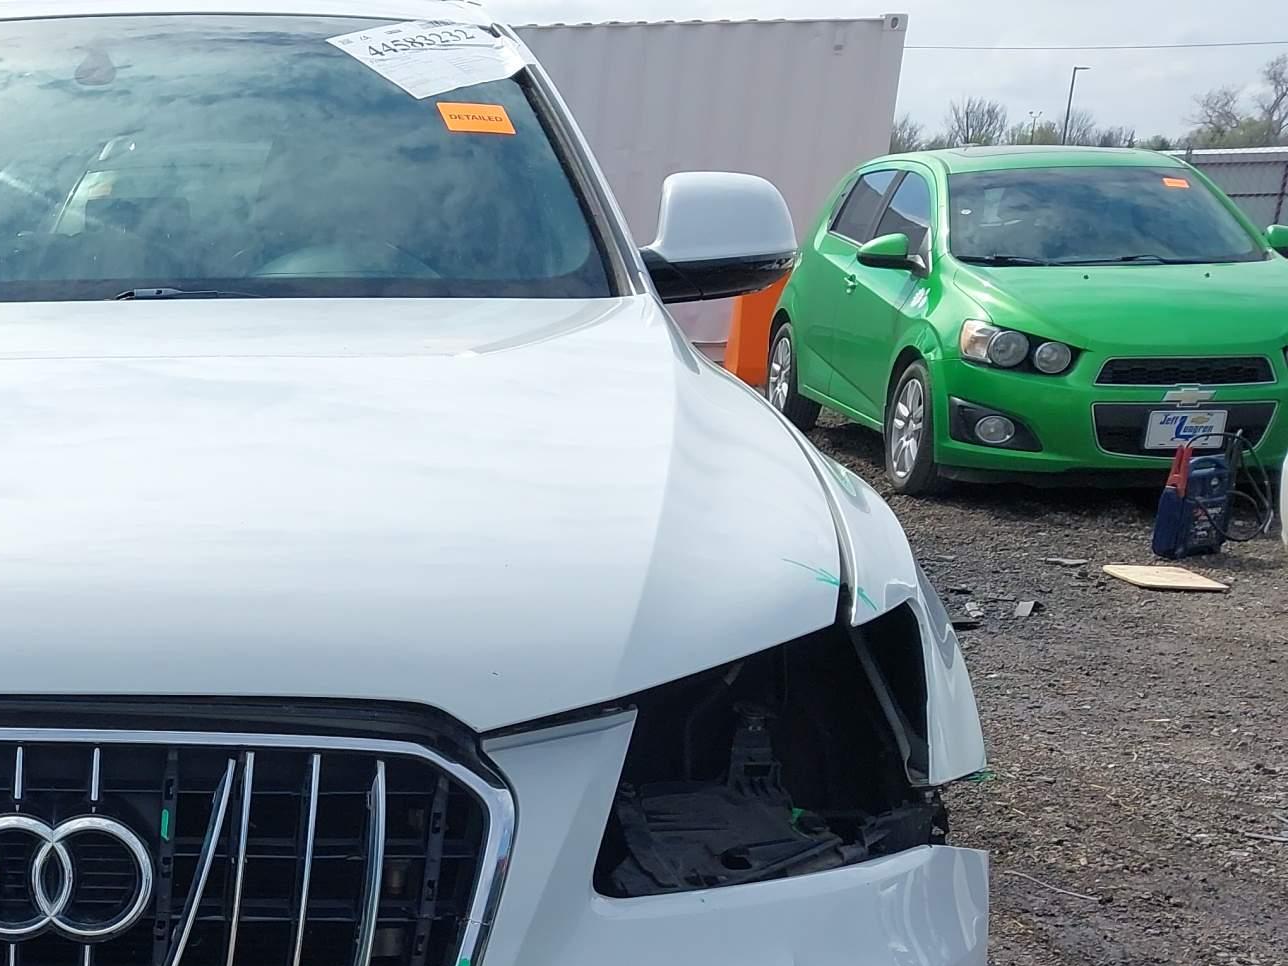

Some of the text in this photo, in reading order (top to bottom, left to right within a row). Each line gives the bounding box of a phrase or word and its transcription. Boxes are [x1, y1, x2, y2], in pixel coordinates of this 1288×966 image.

[367, 29, 475, 58] 44583232
[448, 113, 503, 122] DETAILED
[1159, 414, 1180, 425] Jeff
